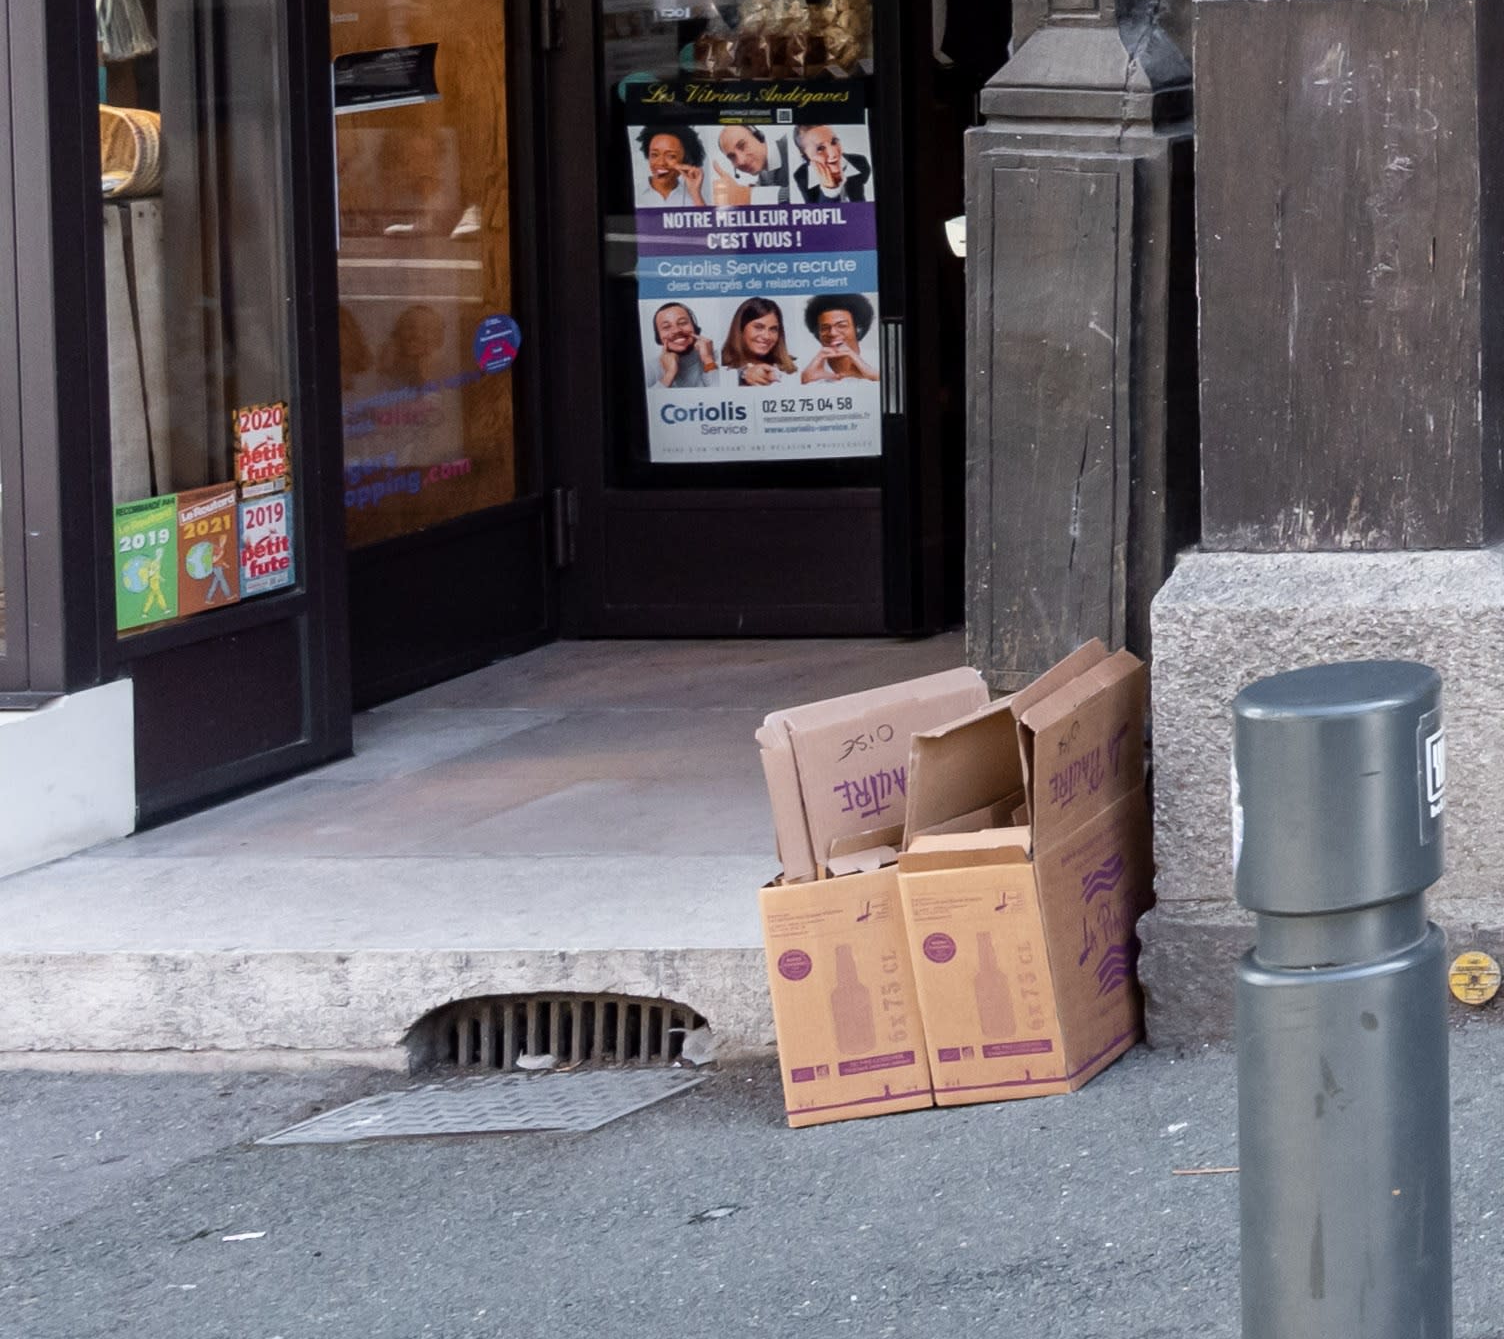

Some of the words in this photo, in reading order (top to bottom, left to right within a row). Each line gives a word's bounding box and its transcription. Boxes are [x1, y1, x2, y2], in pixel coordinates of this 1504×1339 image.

[684, 84, 751, 103] Vitrines
[662, 210, 713, 229] NOTRE
[716, 209, 789, 227] MEILLEUR
[791, 208, 847, 226] PROFIL
[707, 231, 752, 250] C'EST
[753, 230, 793, 249] VOUS
[658, 260, 722, 278] Coriolis
[726, 259, 788, 275] Service
[792, 258, 857, 274] recrute
[667, 278, 690, 292] des
[746, 277, 762, 290] de
[765, 276, 810, 289] relation
[813, 274, 848, 288] client
[240, 407, 284, 433] 2020
[660, 401, 748, 425] Coriolis
[762, 399, 778, 413] 02
[781, 399, 797, 412] 52
[800, 399, 814, 412] 75
[817, 398, 834, 411] 04
[837, 397, 853, 411] 58
[700, 422, 749, 437] Service
[183, 513, 232, 540] 2021
[246, 502, 284, 530] 2019
[119, 528, 170, 553] 2019
